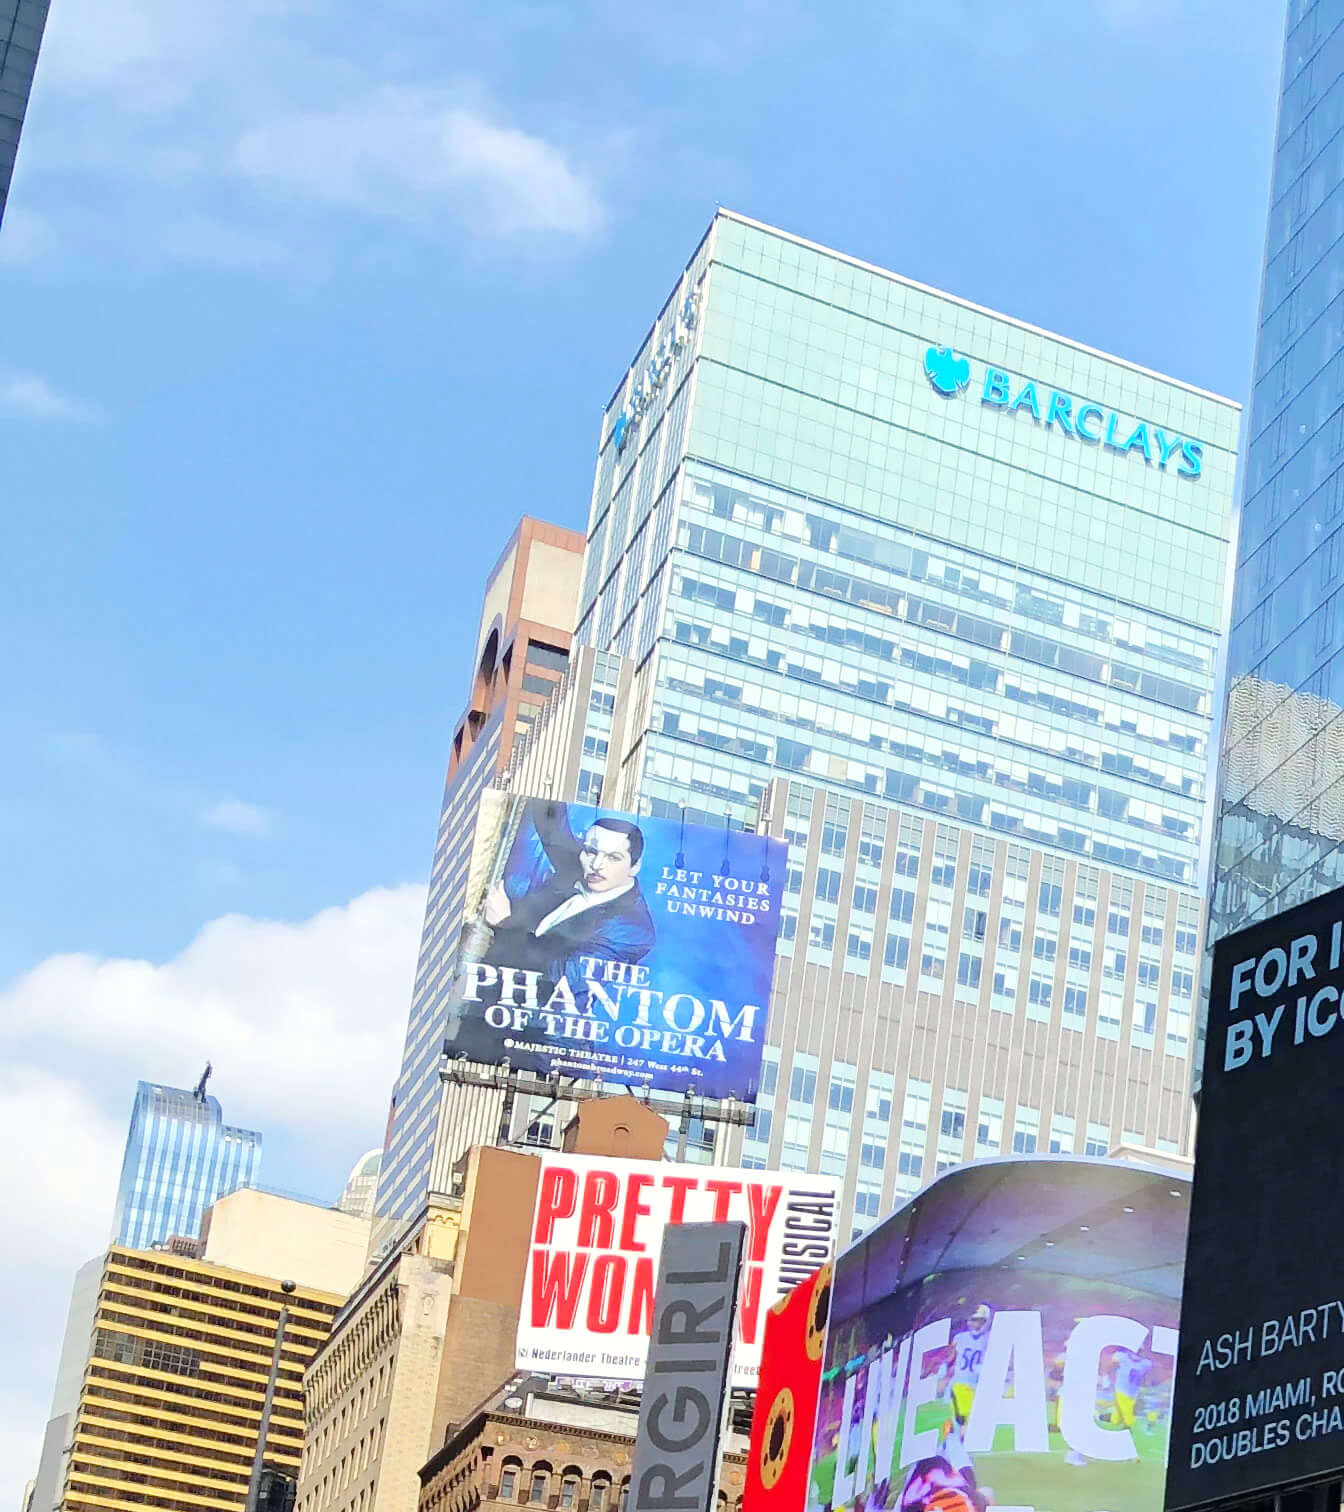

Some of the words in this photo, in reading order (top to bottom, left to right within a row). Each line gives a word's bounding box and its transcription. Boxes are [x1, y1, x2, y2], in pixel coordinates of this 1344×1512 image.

[981, 368, 1202, 479] BARCLAYS
[657, 881, 770, 911] FANTASIES
[662, 866, 702, 884] LET
[712, 875, 770, 896] YOUR
[667, 901, 755, 925] UNWIND
[580, 956, 650, 985] THE
[1230, 934, 1318, 1011] FOR
[461, 960, 760, 1043] PHANTOM
[484, 1004, 532, 1032] OF
[539, 1013, 609, 1043] THE
[614, 1025, 727, 1063] OPERA
[514, 1039, 567, 1057] MAJESTIC
[568, 1049, 619, 1065] THEATRE
[1224, 1005, 1285, 1072] BY
[534, 1166, 783, 1262] PRETTY
[531, 1348, 596, 1363] Nederlander
[601, 1352, 641, 1367] Theatre
[1196, 1326, 1254, 1376] ASH
[832, 1317, 952, 1510] LIVE
[1193, 1402, 1239, 1433] 2018
[1245, 1377, 1316, 1418] MIAMI,
[1190, 1418, 1289, 1469] DOUBLES
